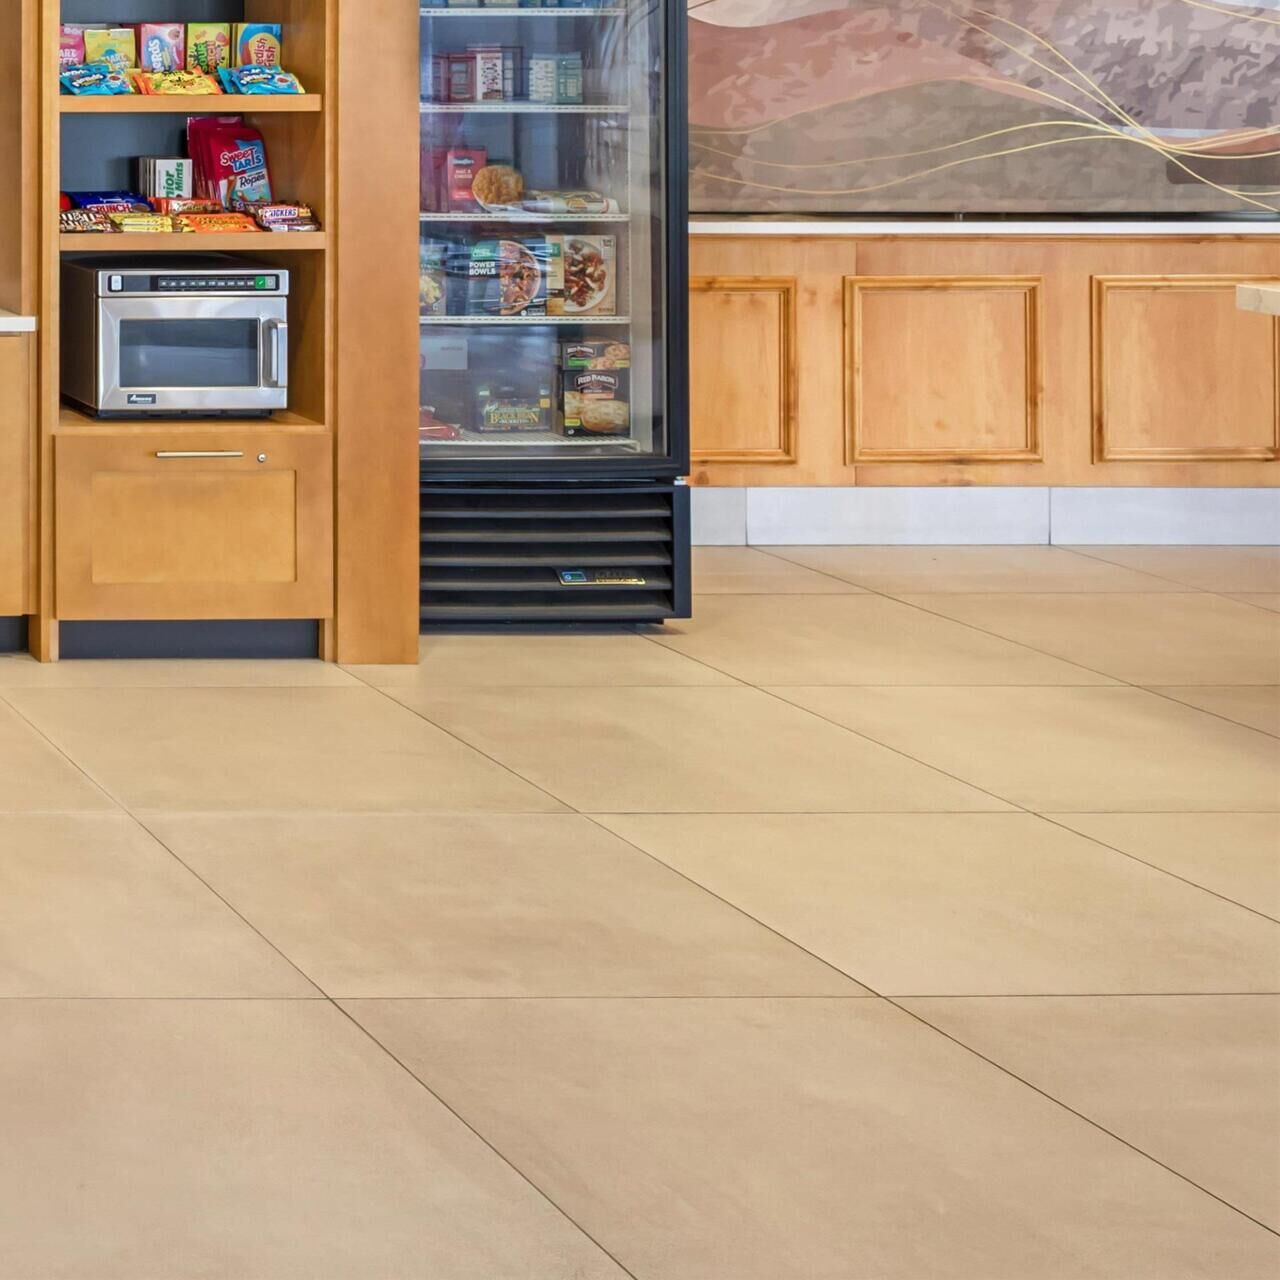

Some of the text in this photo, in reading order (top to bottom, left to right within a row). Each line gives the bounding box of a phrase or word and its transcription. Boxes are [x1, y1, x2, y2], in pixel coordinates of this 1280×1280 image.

[255, 37, 268, 65] edish
[163, 170, 175, 198] nior
[175, 162, 184, 192] Mints
[239, 173, 265, 189] Ropes
[469, 261, 495, 269] POWER
[469, 268, 496, 276] BOWLS
[578, 374, 615, 385] RED BARON
